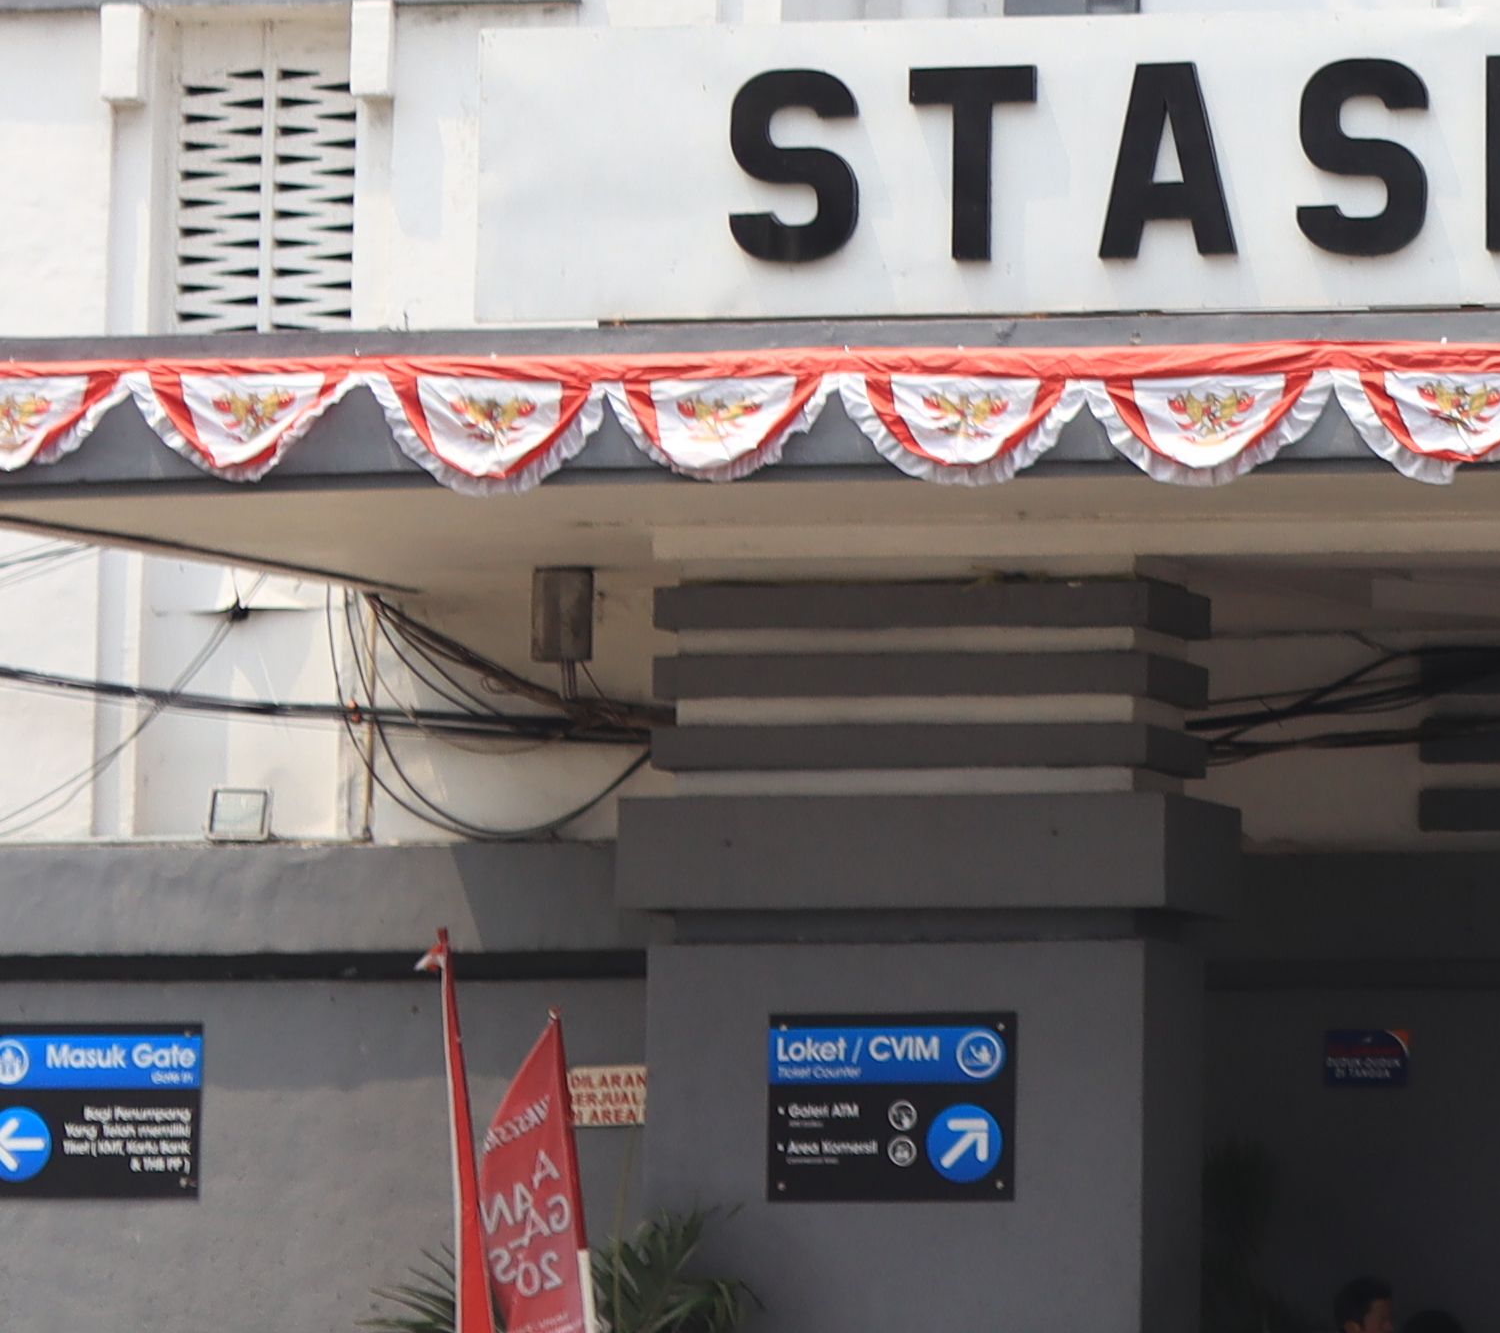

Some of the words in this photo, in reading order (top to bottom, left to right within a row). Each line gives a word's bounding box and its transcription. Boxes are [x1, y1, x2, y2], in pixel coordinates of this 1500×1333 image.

[46, 1043, 127, 1069] Masuk
[131, 1043, 197, 1069] Gate
[776, 1036, 848, 1062] Loket
[868, 1035, 941, 1062] CVIM
[812, 1066, 862, 1079] Counter
[573, 1091, 641, 1107] ERJUAL
[831, 1103, 860, 1118] ATM
[64, 1121, 98, 1140] Yang
[786, 1139, 820, 1155] Area
